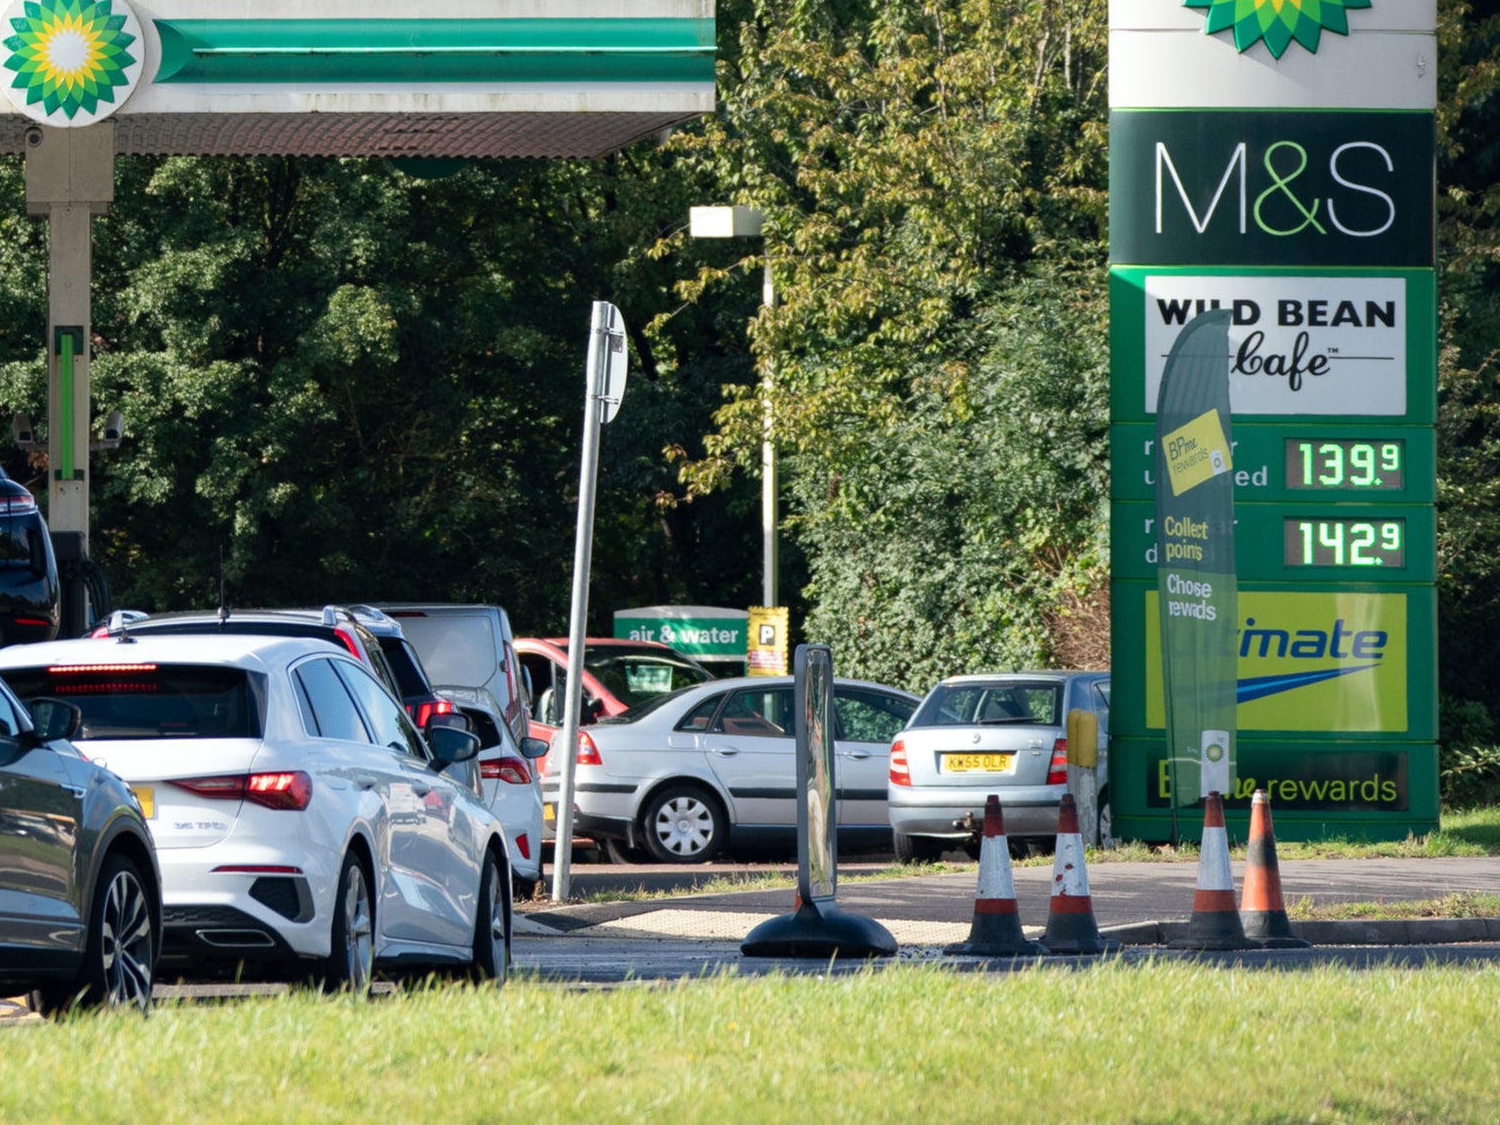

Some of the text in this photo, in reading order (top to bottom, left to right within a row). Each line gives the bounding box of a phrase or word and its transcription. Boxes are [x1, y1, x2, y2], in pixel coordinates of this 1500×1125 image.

[1155, 141, 1395, 237] M&S
[1277, 300, 1396, 327] BEAN
[1231, 331, 1331, 391] Cafe
[1164, 516, 1208, 540] Collect
[630, 625, 739, 644] air & water
[761, 625, 775, 644] P
[1237, 617, 1388, 659] imate
[983, 755, 1008, 769] OLR
[1266, 774, 1397, 802] rewards
